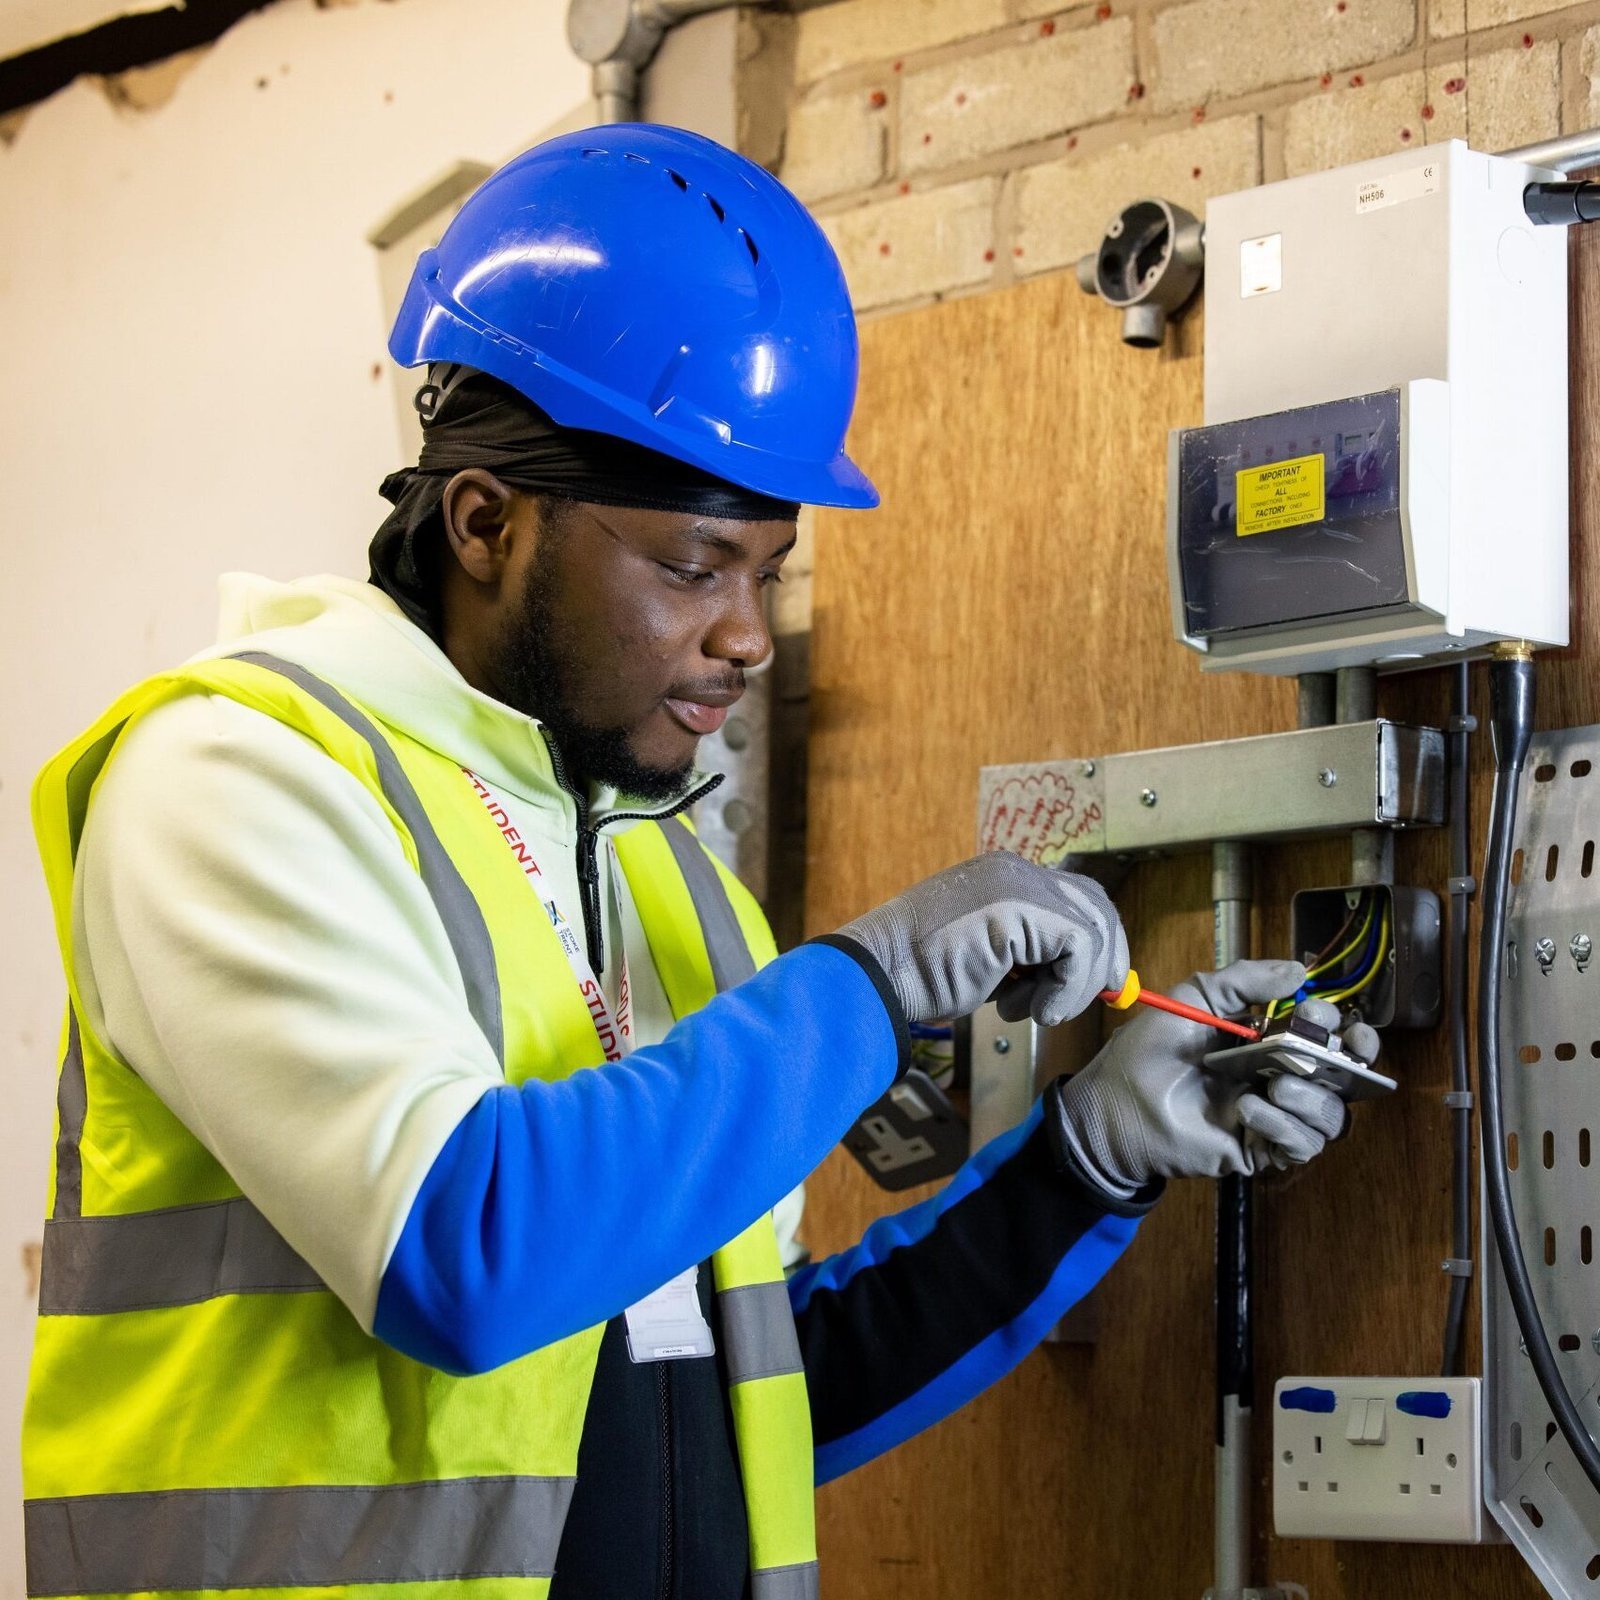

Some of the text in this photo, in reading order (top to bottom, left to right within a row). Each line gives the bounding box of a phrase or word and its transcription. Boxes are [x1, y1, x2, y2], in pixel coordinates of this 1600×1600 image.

[1359, 189, 1385, 204] NH506
[1259, 465, 1301, 481] IMPORTANT
[1275, 487, 1287, 497] ALL
[1255, 505, 1286, 518] FACTORY
[1283, 513, 1315, 524] INSTALLATION
[559, 930, 573, 954] TRENT
